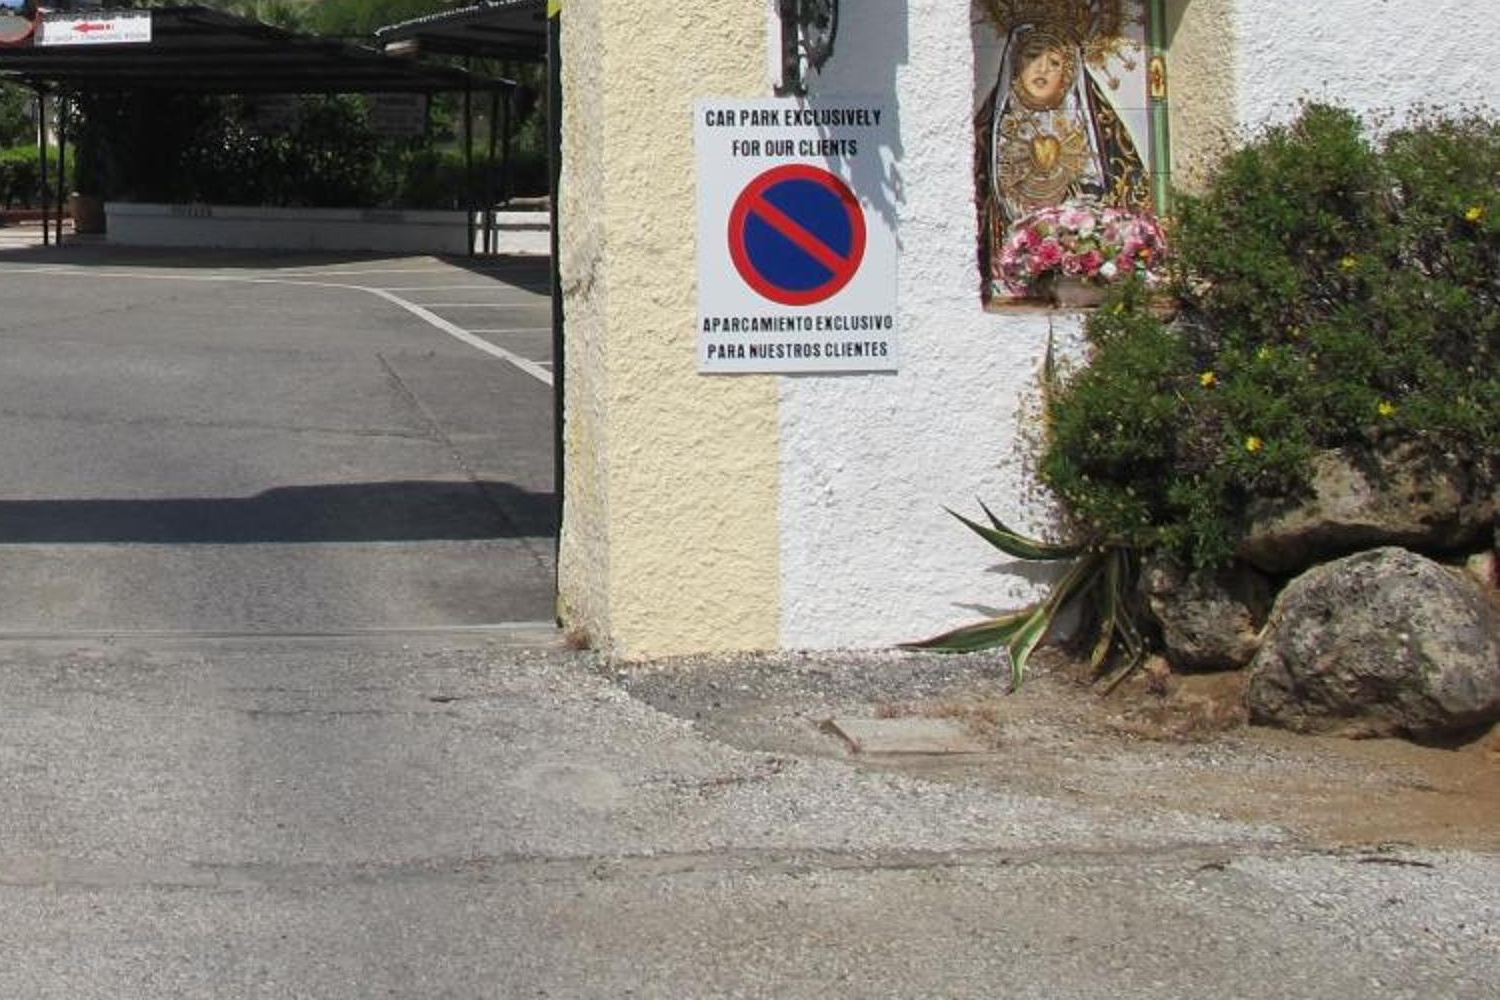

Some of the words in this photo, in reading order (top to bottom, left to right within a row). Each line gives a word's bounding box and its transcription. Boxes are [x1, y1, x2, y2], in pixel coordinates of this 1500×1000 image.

[706, 109, 735, 127] CAR
[740, 109, 779, 127] PARK
[785, 109, 881, 127] EXCLUSIVELY
[733, 140, 761, 157] FOR
[765, 140, 795, 157] OUR
[800, 139, 857, 157] CLIENTS
[703, 317, 812, 333] APARCAMIENTO
[816, 315, 893, 331] EXCLUSIVO
[708, 344, 745, 359] PARA
[750, 343, 821, 358] NUESTROS
[825, 342, 888, 358] CLIENTES
